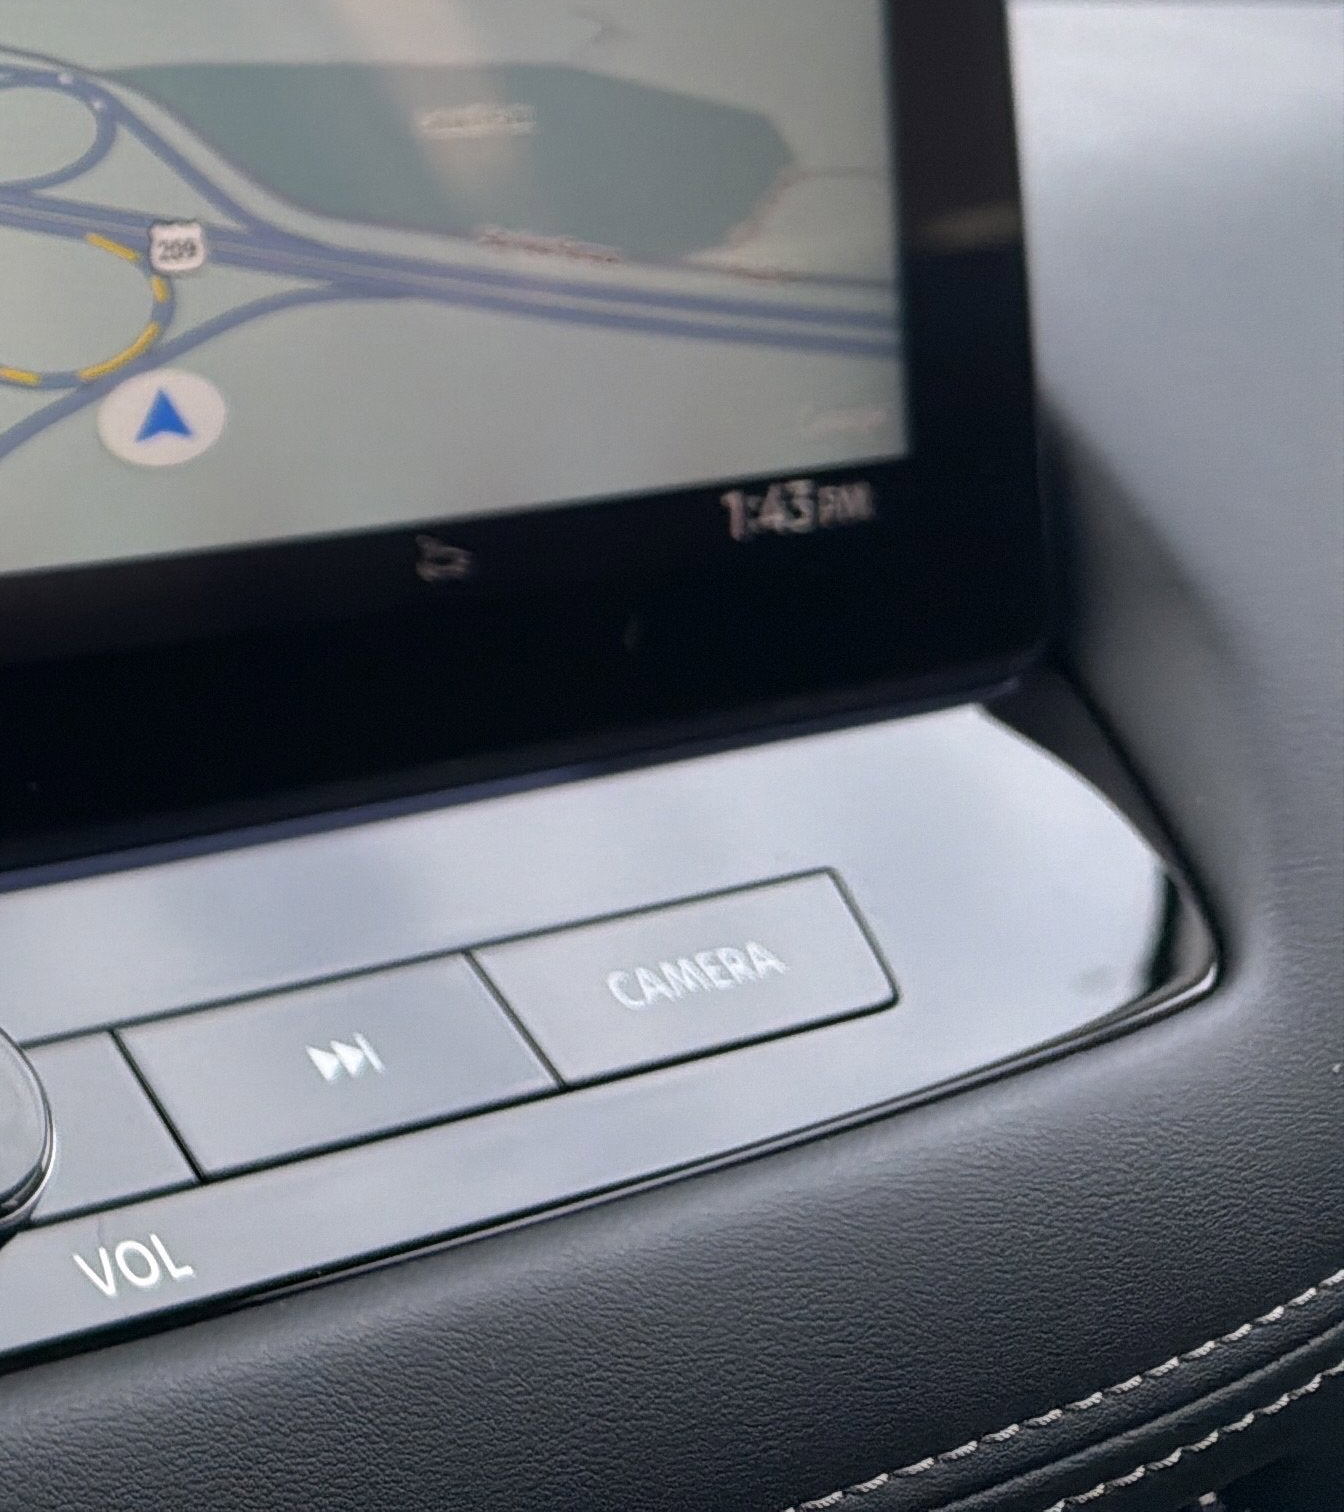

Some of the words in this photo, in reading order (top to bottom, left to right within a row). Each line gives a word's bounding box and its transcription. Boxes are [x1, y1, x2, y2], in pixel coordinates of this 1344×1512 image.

[158, 237, 197, 261] 209
[720, 478, 813, 540] 1:43
[817, 481, 873, 527] PM
[609, 940, 790, 1012] CAMERA
[72, 1233, 195, 1297] VOL
